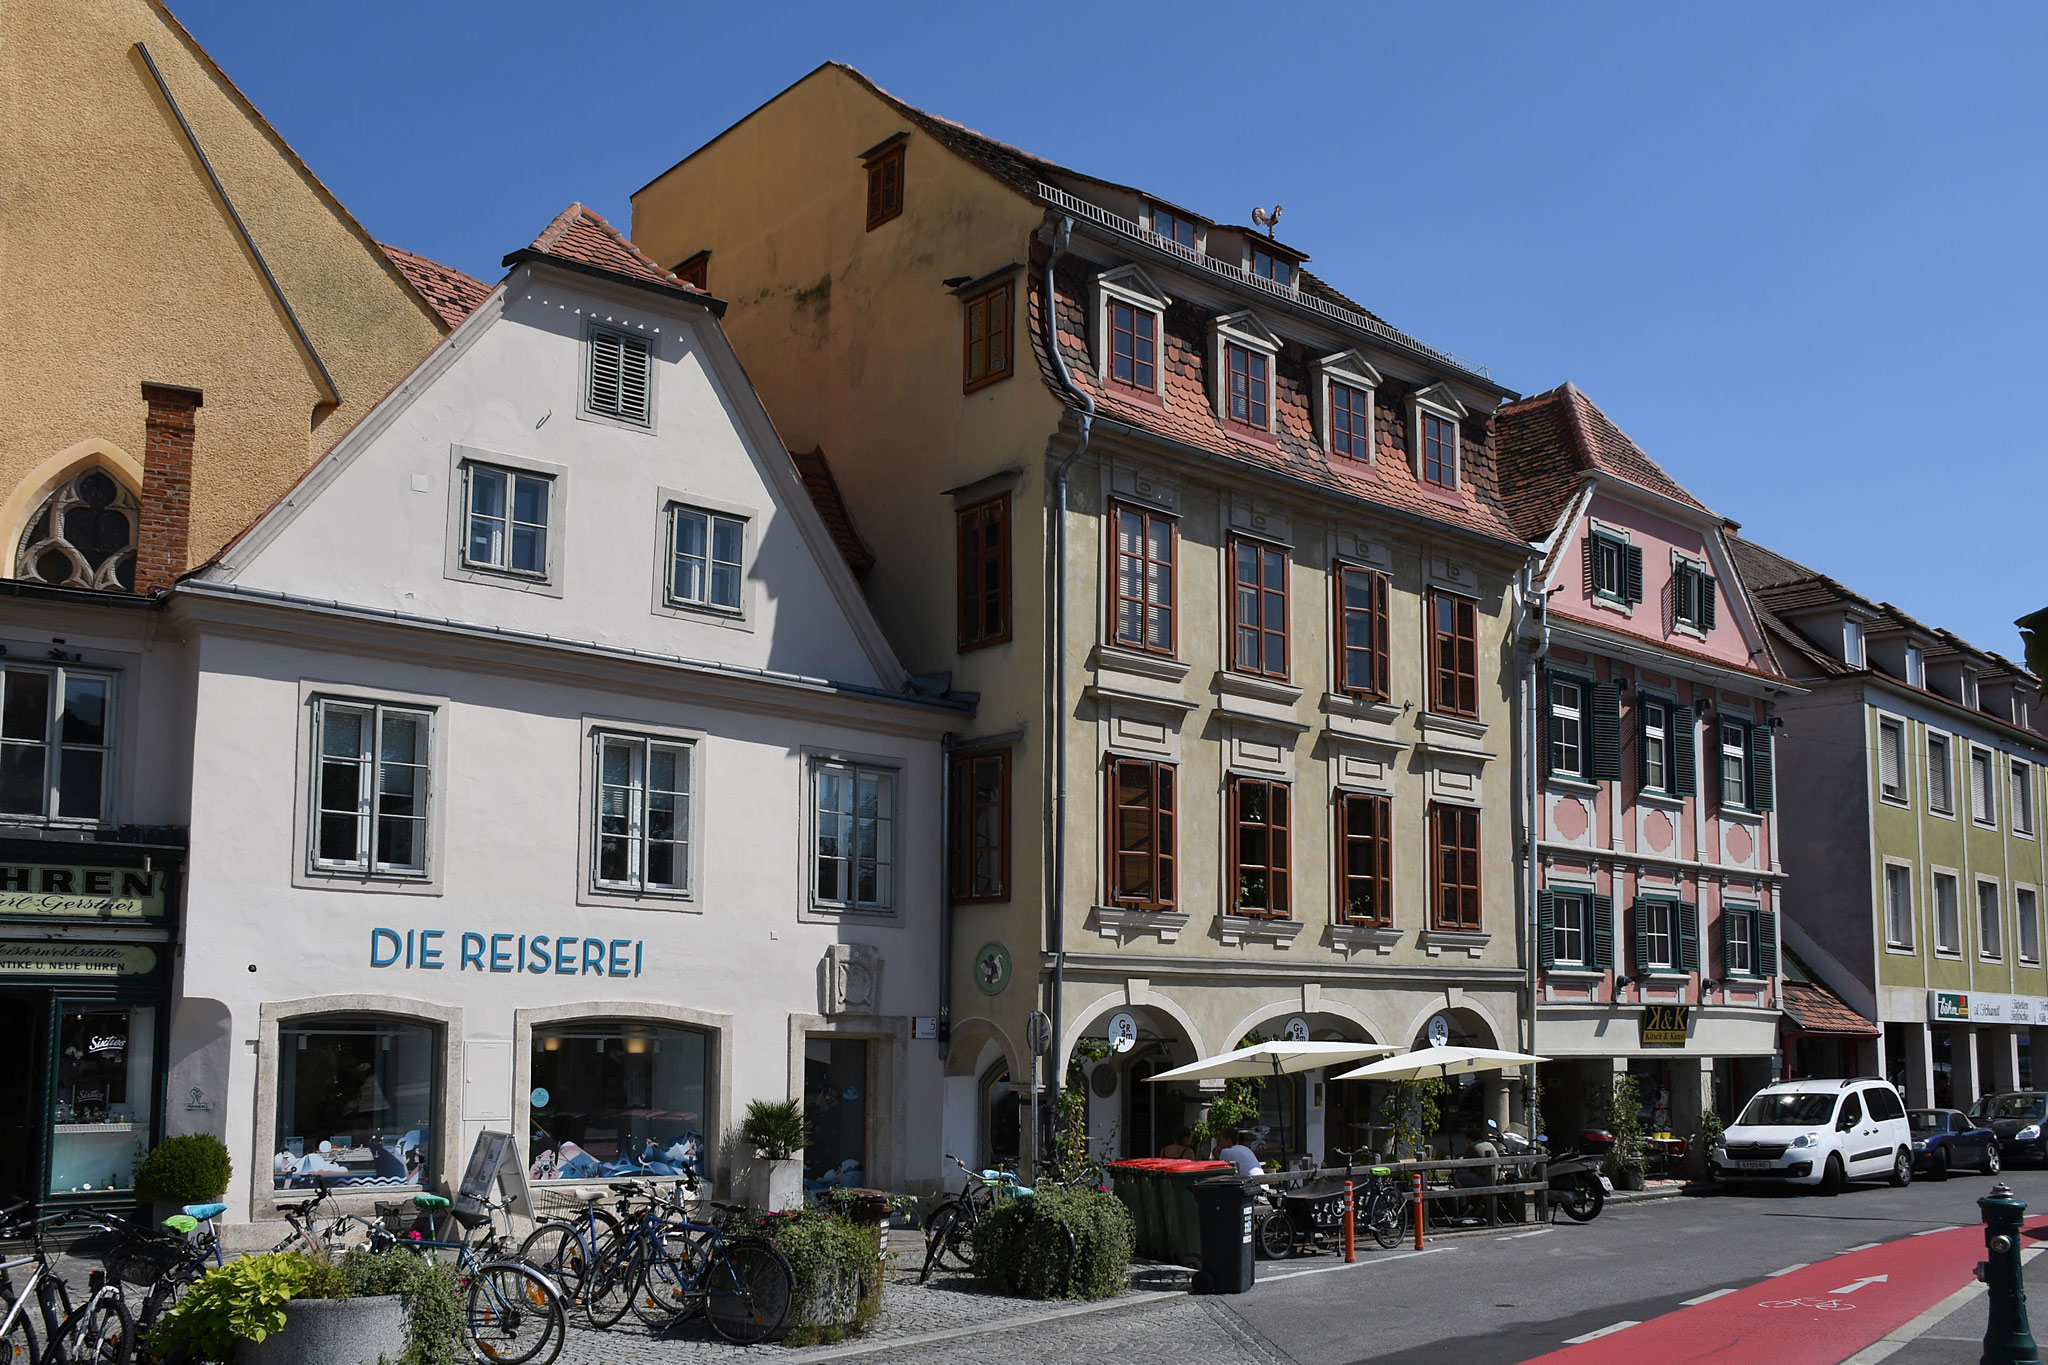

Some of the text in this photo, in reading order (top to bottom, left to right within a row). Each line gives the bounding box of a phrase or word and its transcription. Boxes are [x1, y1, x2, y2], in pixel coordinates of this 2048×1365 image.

[37, 895, 145, 913] Gerstner
[0, 944, 125, 960] eisterwerkstätte
[371, 928, 643, 977] DIE REISEREI
[50, 962, 81, 970] NEUE
[85, 962, 125, 971] UHREN
[930, 1019, 936, 1030] 5
[88, 1035, 127, 1052] Sixties
